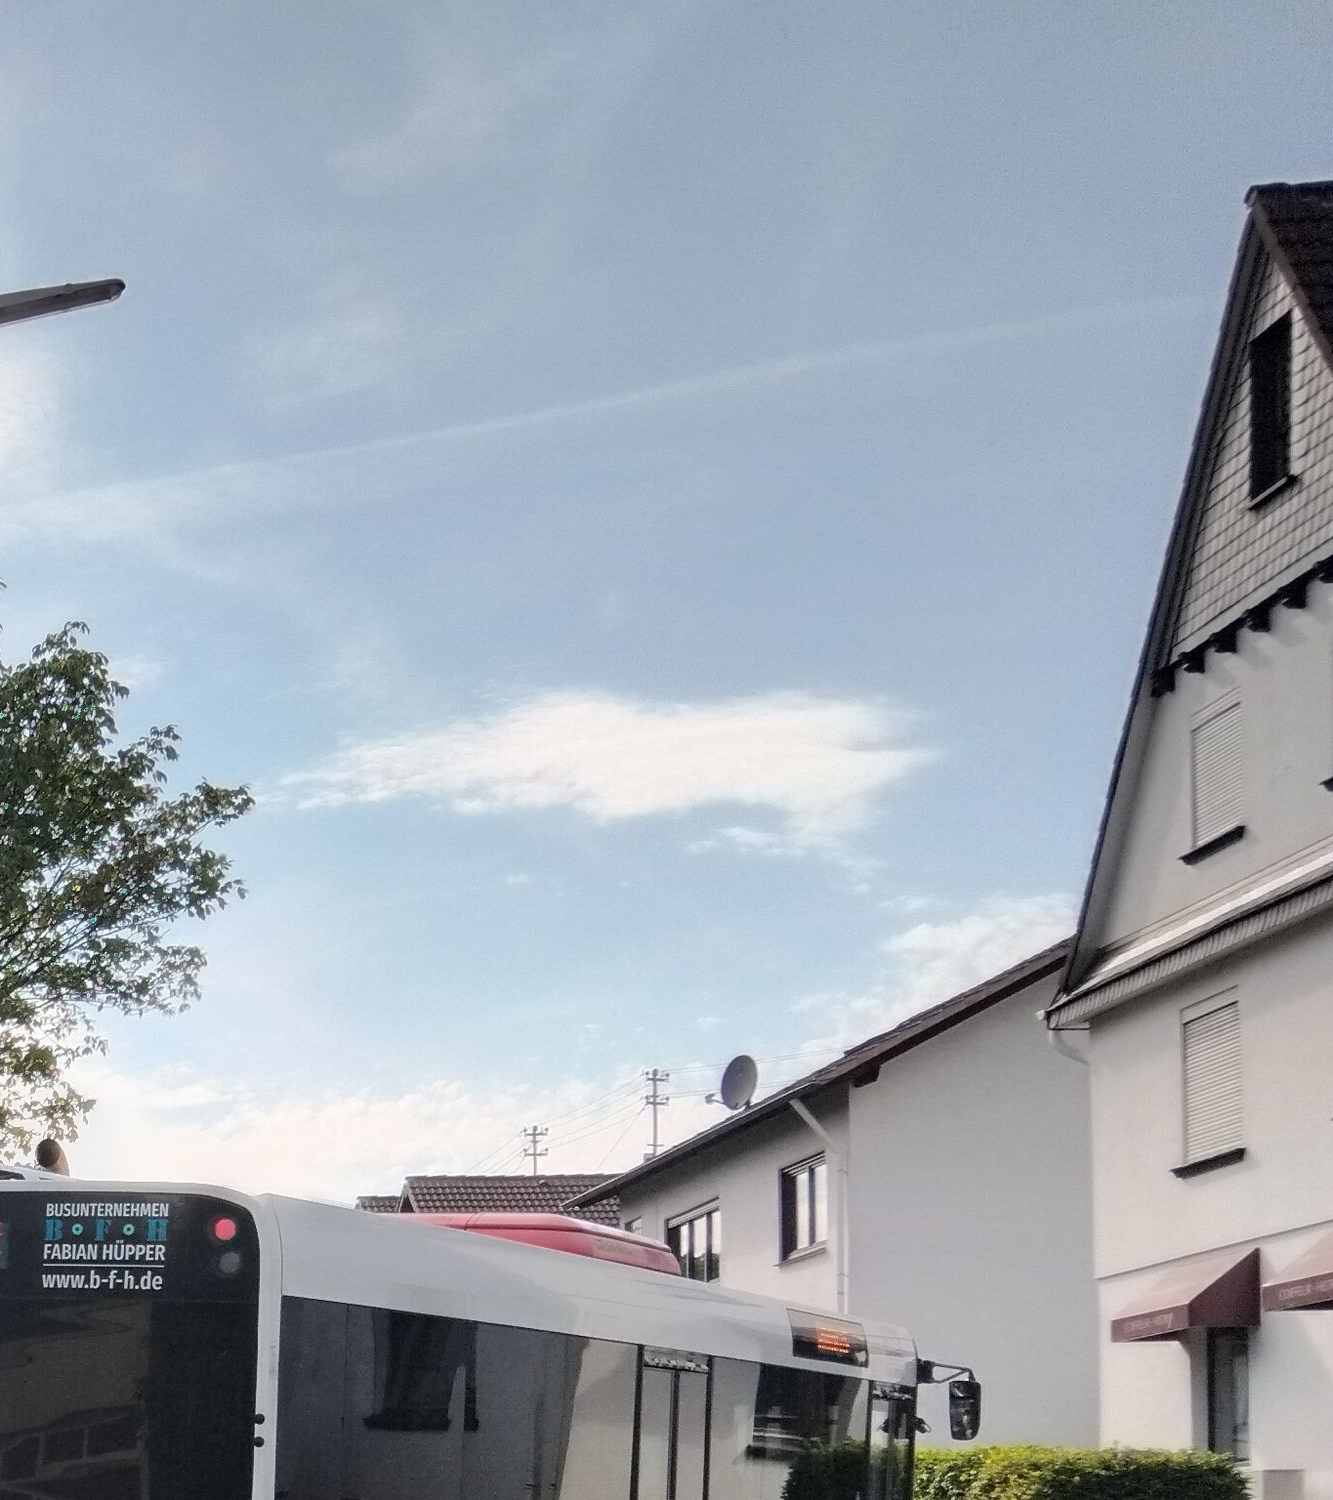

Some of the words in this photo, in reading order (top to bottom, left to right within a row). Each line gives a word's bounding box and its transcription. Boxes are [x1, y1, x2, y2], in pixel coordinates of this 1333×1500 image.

[45, 1202, 170, 1218] BUSUNTERNEHMEN
[43, 1243, 98, 1261] FABIAN
[101, 1239, 167, 1262] HÜPPER
[41, 1269, 164, 1290] www.b-f-h.de
